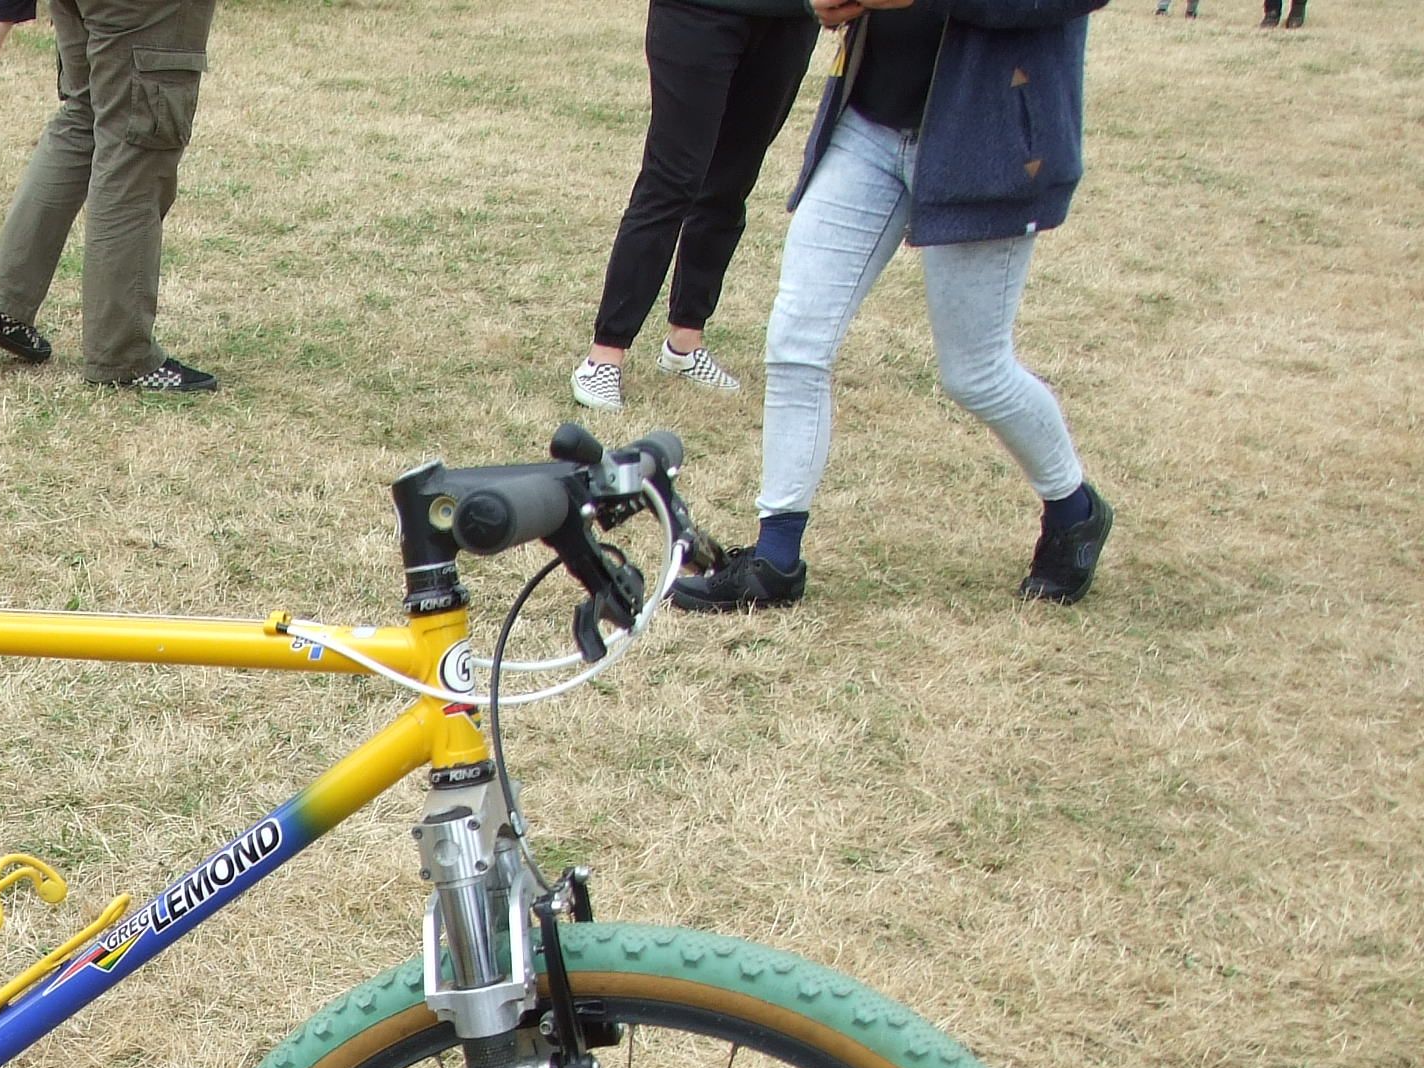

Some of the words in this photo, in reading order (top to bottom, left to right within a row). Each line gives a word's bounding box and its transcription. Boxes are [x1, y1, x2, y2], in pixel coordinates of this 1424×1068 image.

[420, 594, 452, 612] KING
[448, 767, 481, 783] KING
[107, 910, 149, 949] GREG
[150, 821, 281, 932] LEMOND
